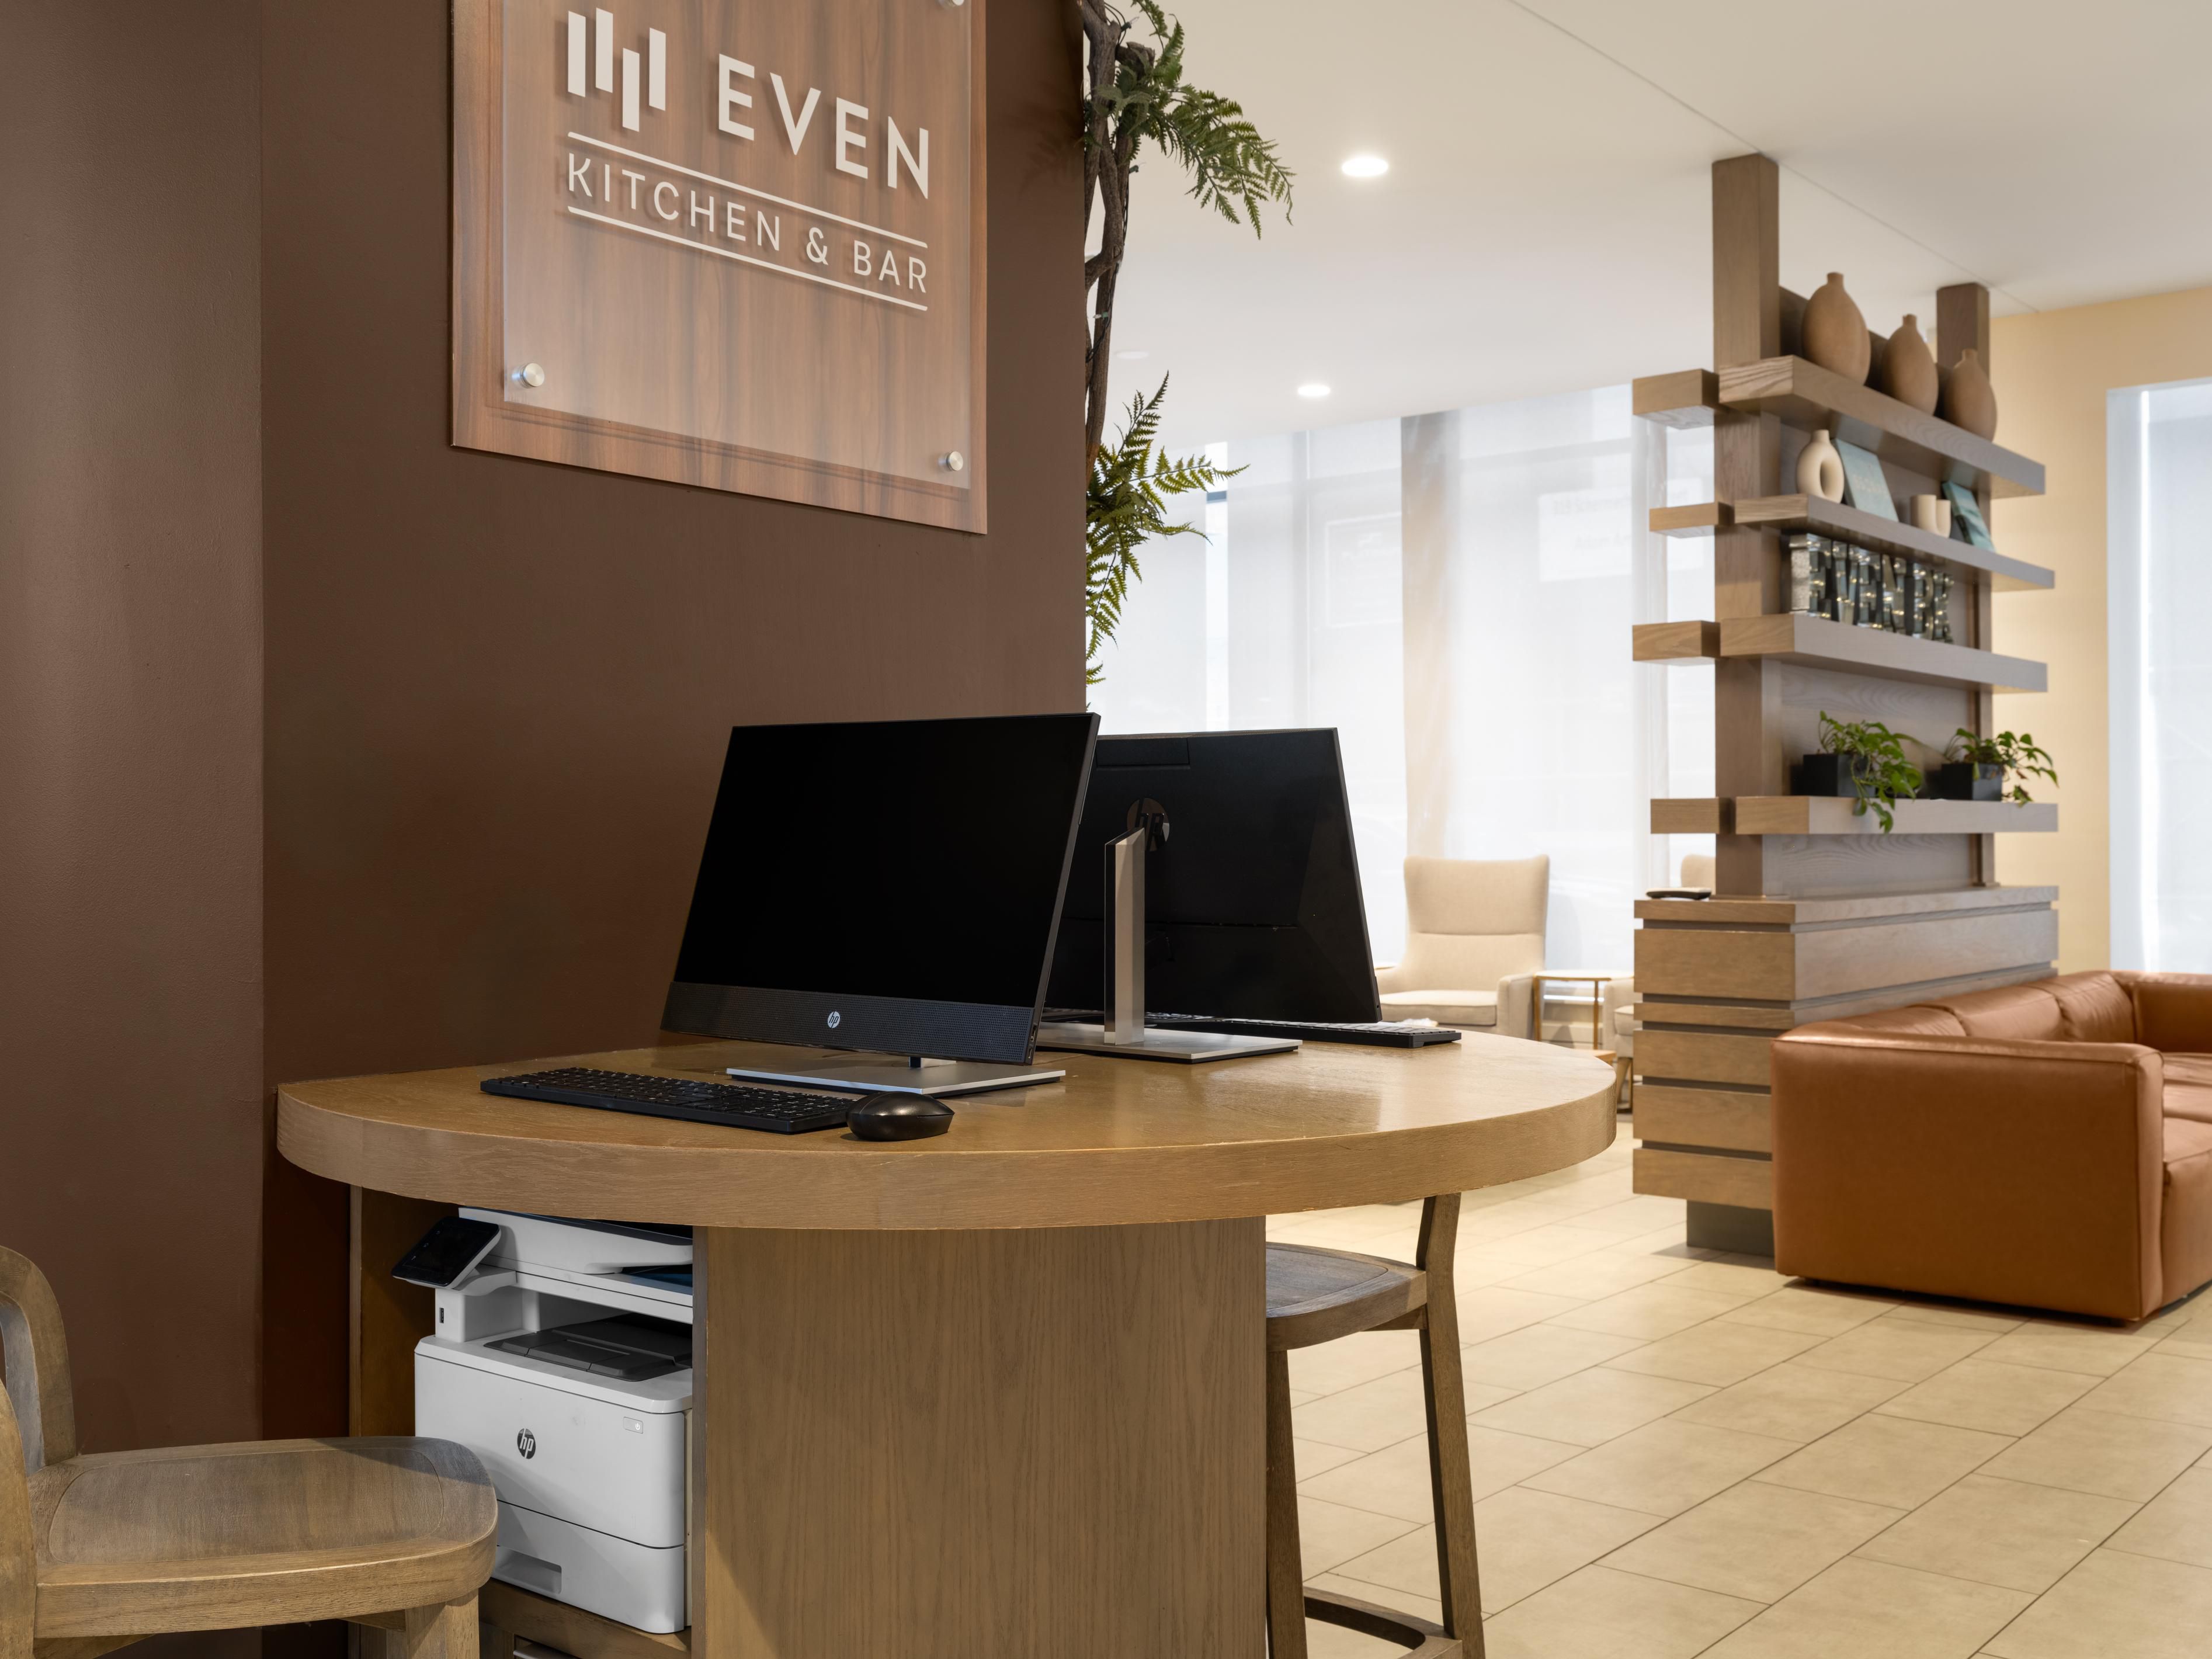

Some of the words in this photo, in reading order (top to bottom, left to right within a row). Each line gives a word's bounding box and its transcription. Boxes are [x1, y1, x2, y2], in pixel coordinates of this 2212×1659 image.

[718, 53, 929, 200] EVEN
[568, 152, 780, 251] KITCHEN
[806, 227, 829, 265] &
[854, 240, 928, 293] BAR
[1804, 533, 1907, 633] EVEN
[828, 1011, 839, 1028] hp
[519, 1428, 534, 1459] hp
